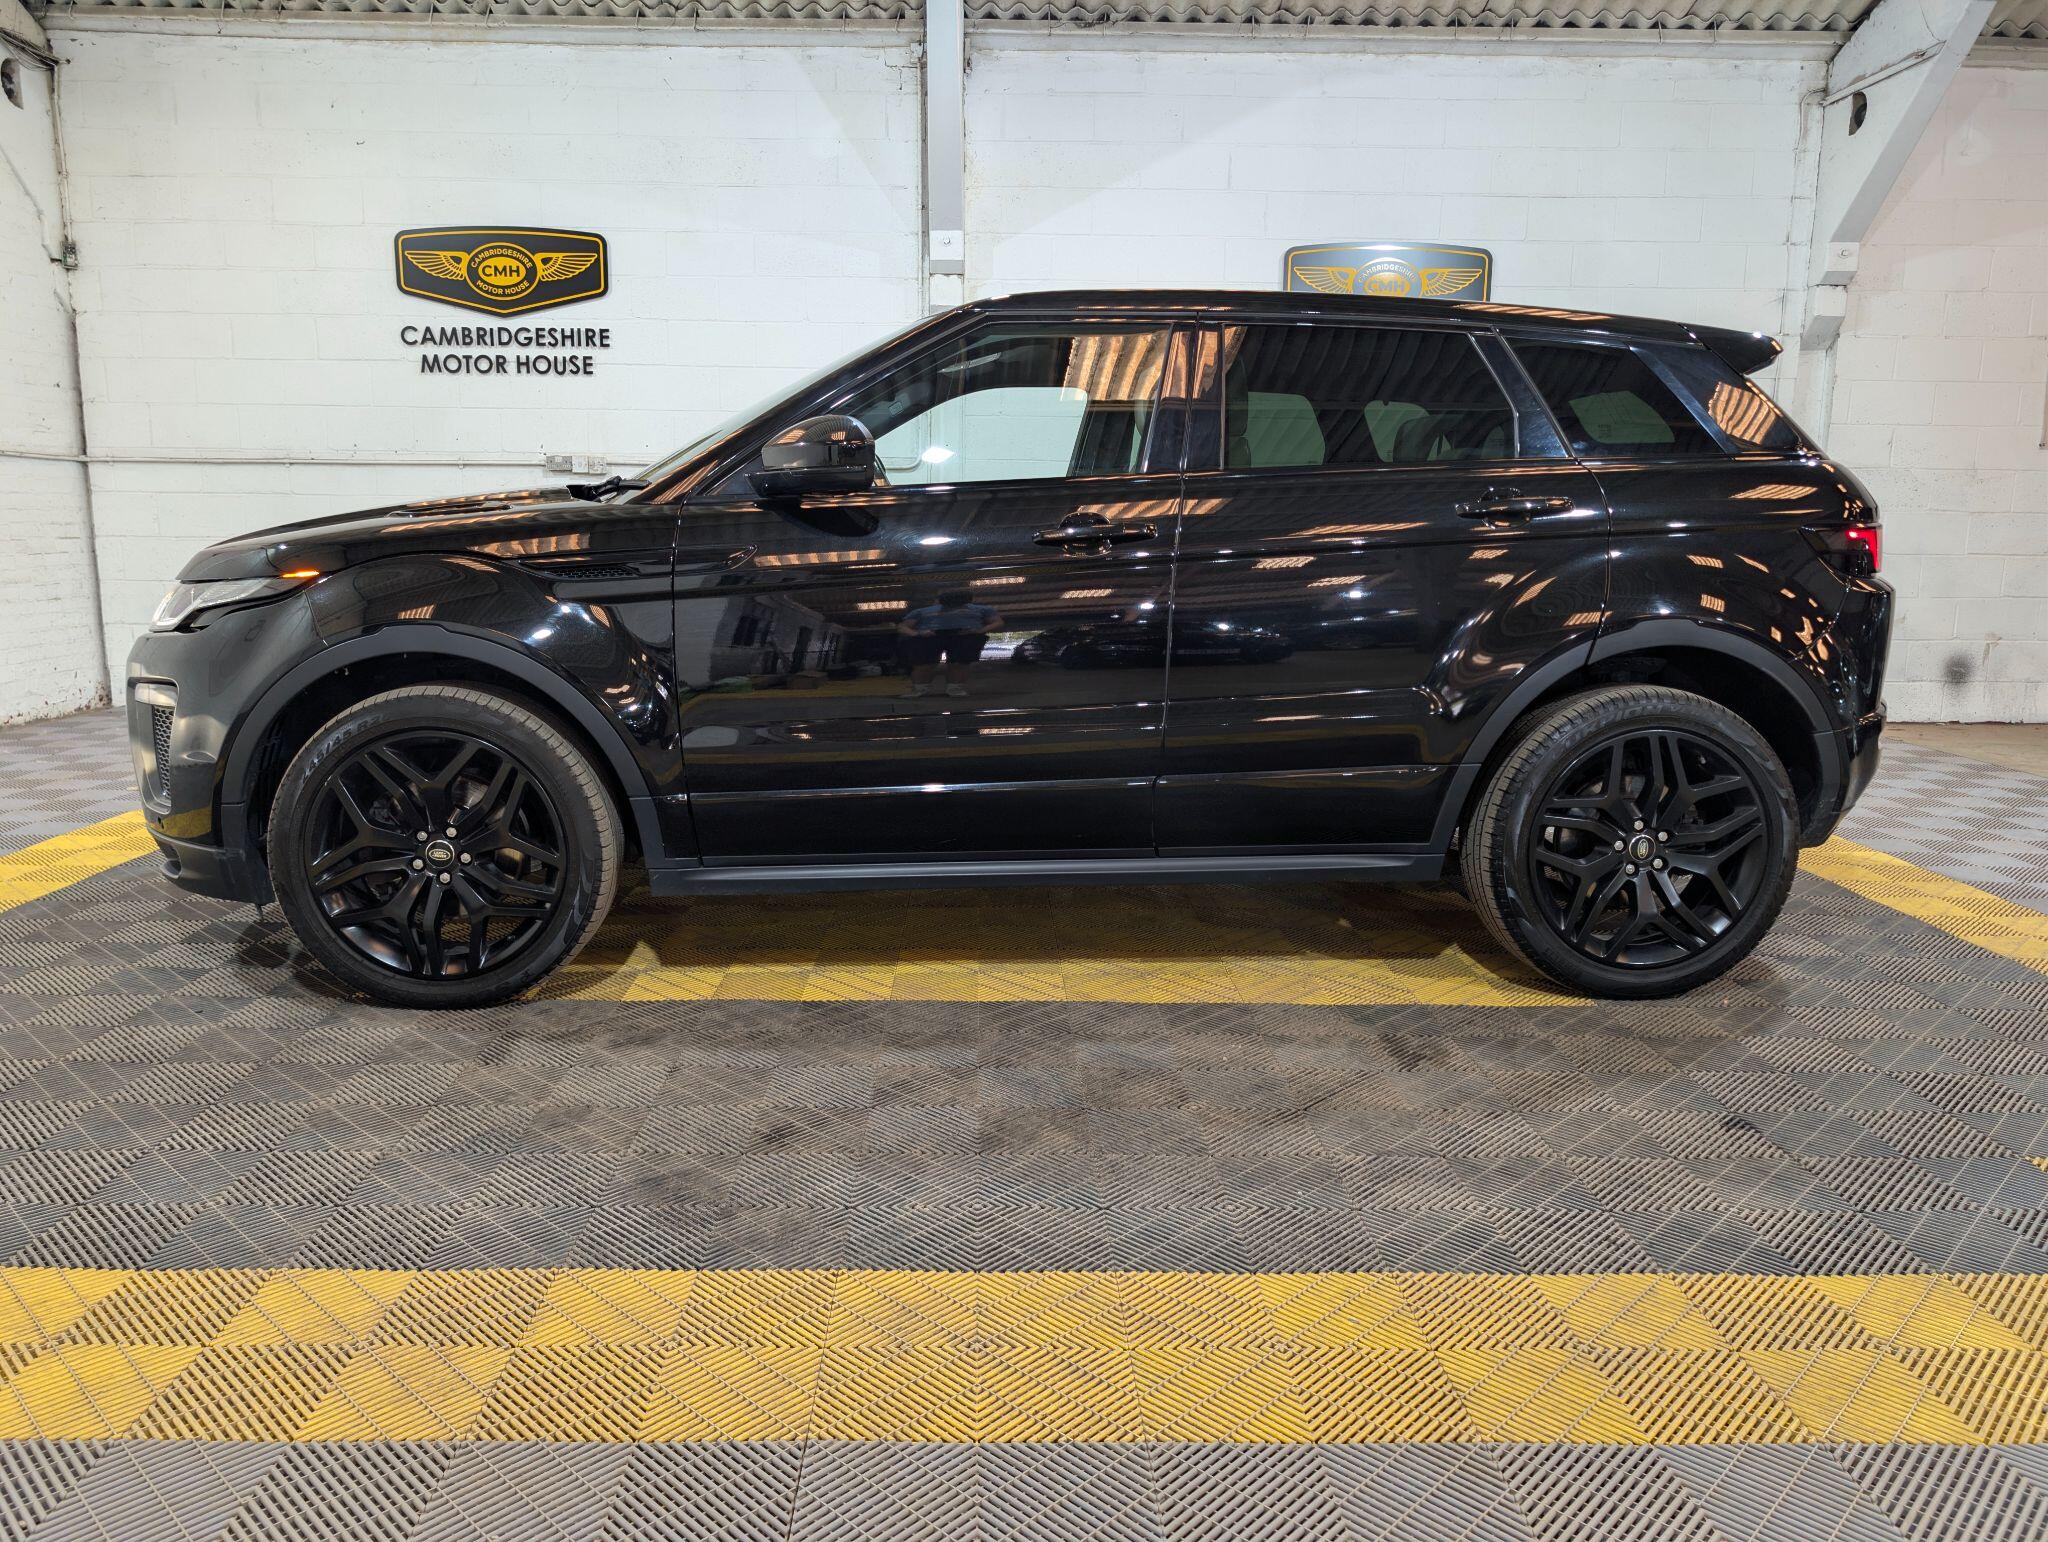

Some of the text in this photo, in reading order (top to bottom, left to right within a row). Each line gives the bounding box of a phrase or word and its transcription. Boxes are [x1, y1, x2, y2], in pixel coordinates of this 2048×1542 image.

[471, 248, 533, 269] CAMBRIDGESHIRE
[481, 264, 521, 278] CMH
[476, 279, 530, 295] MOTOR HOUSE
[1368, 279, 1406, 293] CMH
[400, 326, 611, 348] CAMBRIDGESHIRE
[421, 354, 594, 375] MOTOR HOUSE
